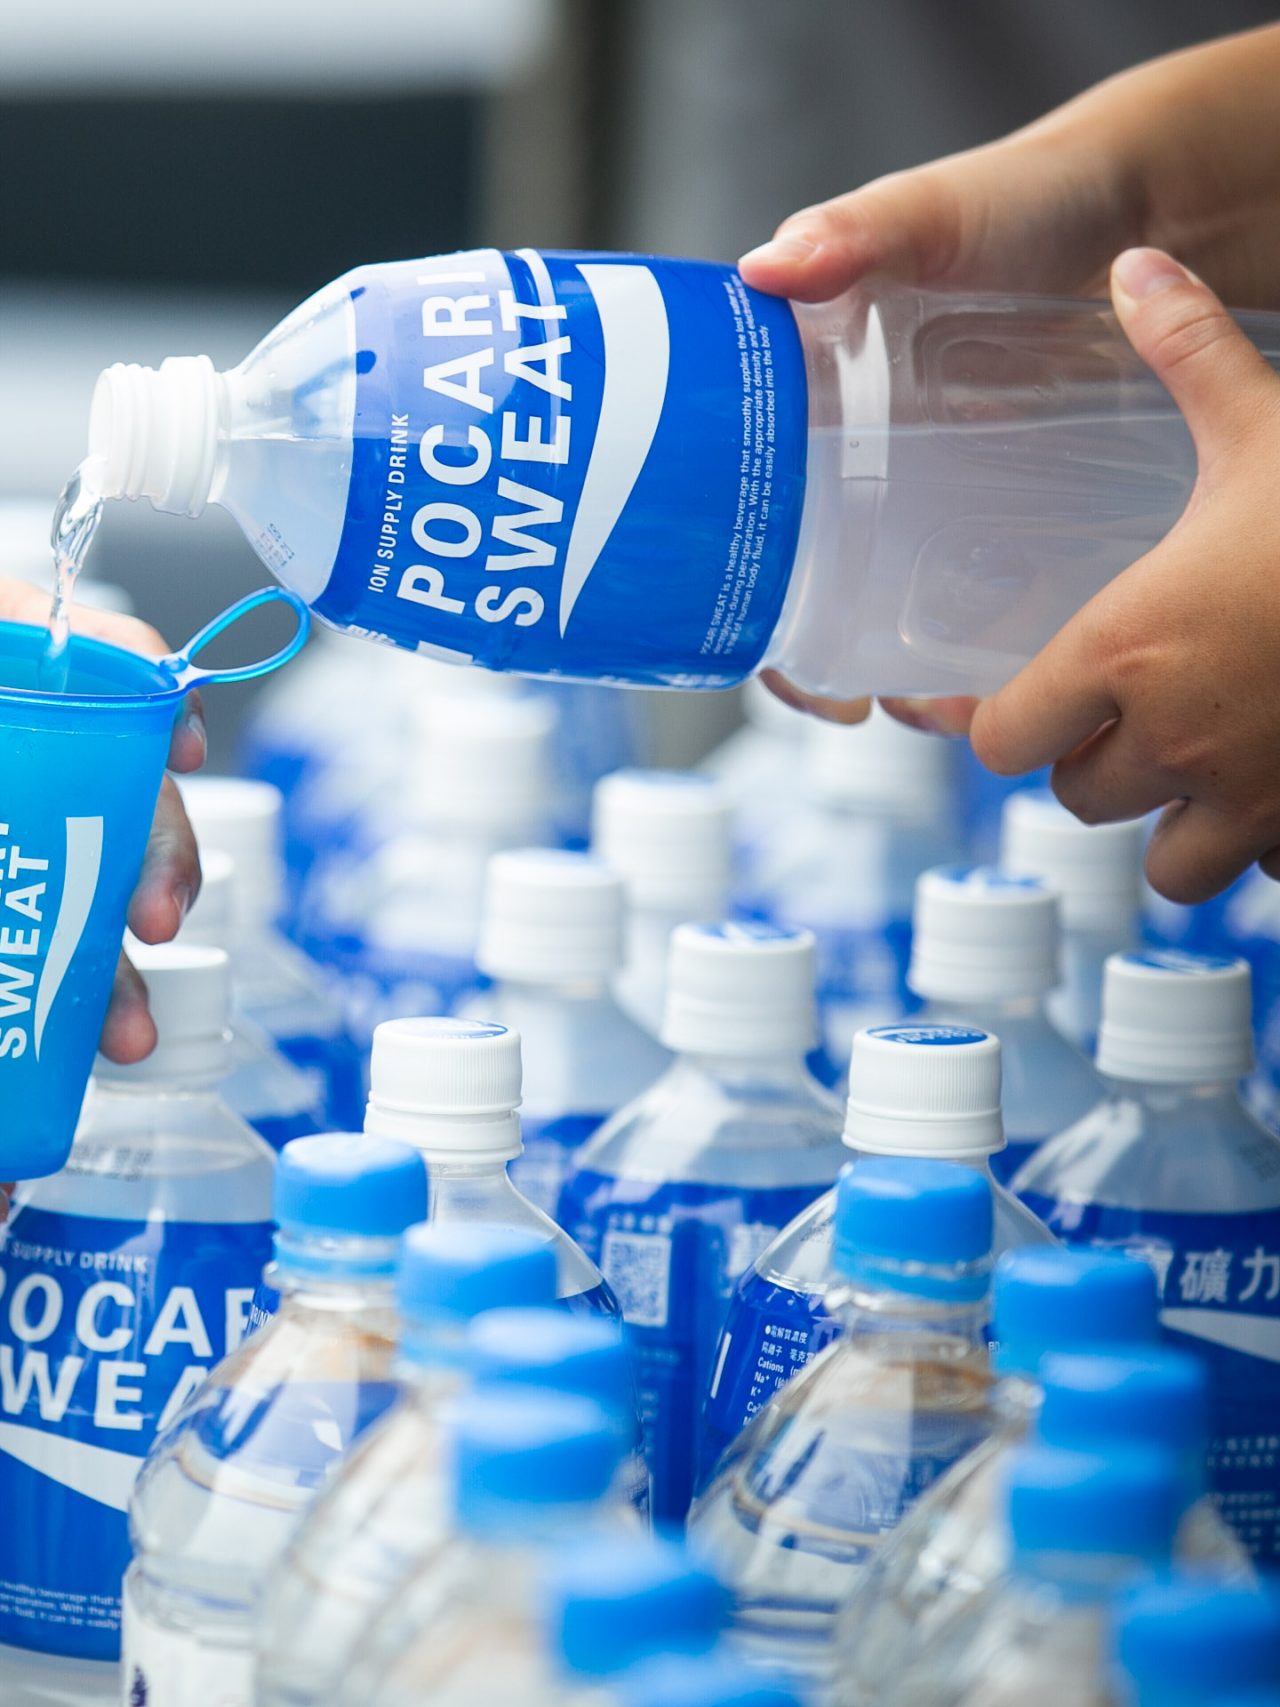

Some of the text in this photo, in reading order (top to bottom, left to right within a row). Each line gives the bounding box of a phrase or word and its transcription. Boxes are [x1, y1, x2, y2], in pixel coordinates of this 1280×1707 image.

[734, 316, 744, 332] lost
[746, 330, 758, 348] and
[737, 334, 747, 349] the
[740, 352, 752, 393] supplies
[752, 349, 763, 387] density
[763, 349, 773, 366] the
[764, 367, 775, 388] into
[741, 395, 753, 447] smoothly
[754, 389, 764, 455] appropriate
[765, 390, 776, 443] absorbed
[396, 269, 494, 616] POCARI
[474, 288, 572, 628] SWEAT
[741, 449, 751, 473] that
[751, 458, 762, 476] the
[764, 446, 776, 479] easily
[368, 413, 409, 593] ION SUPPLY DRINK
[733, 476, 750, 530] beverage
[748, 479, 760, 506] With
[761, 481, 772, 497] be
[761, 498, 771, 521] can
[757, 522, 768, 531] it
[725, 532, 743, 573] healthy
[738, 509, 757, 578] perspiration.
[751, 532, 766, 561] fluid,
[720, 582, 731, 593] is
[725, 573, 733, 581] a
[746, 561, 761, 588] body
[711, 593, 729, 627] SWEAT
[729, 579, 746, 612] during
[737, 589, 753, 622] human
[10, 1240, 149, 1275] SUPPLY DRINK
[757, 1356, 784, 1374] Cations
